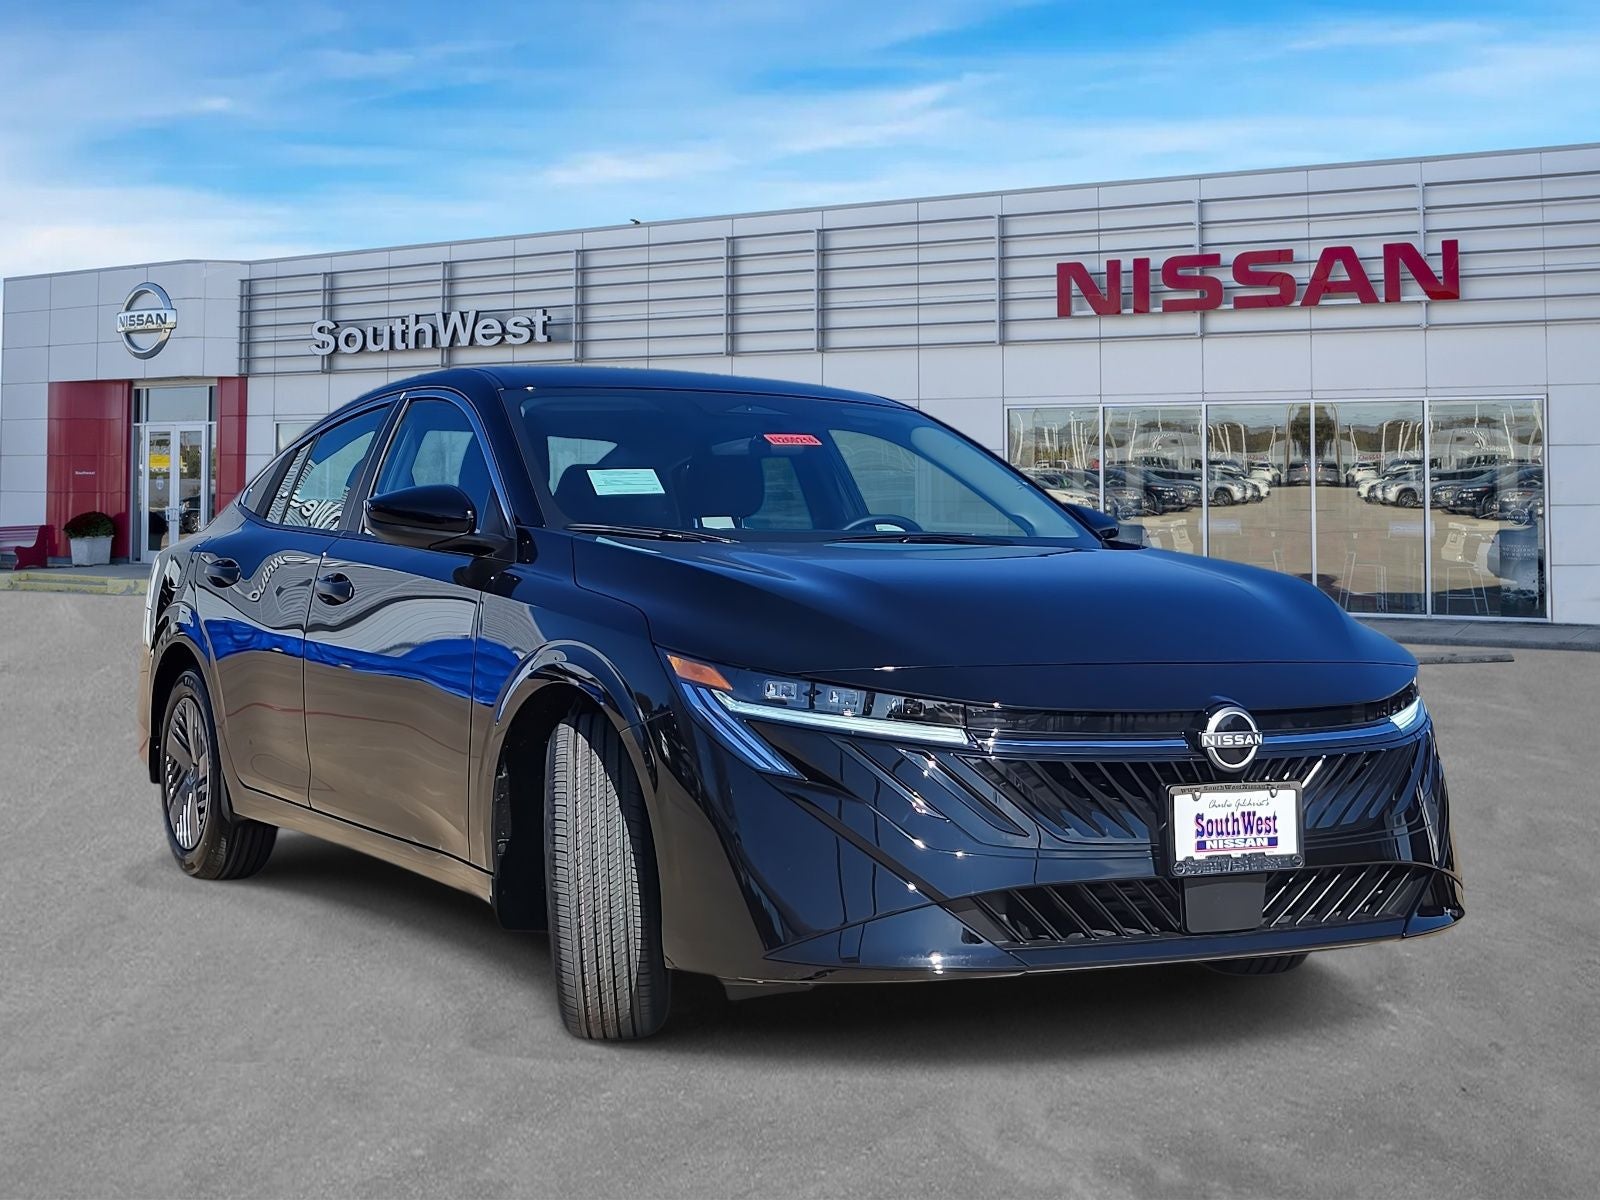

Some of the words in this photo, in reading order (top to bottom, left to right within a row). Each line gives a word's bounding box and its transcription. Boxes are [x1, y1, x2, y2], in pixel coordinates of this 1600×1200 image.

[1056, 239, 1461, 317] NISSAN
[118, 312, 168, 328] NISSAN
[309, 308, 551, 356] SouthWest
[1203, 733, 1263, 746] NISSAN
[1194, 809, 1278, 838] SouthWest
[1205, 836, 1268, 849] NISSAN
